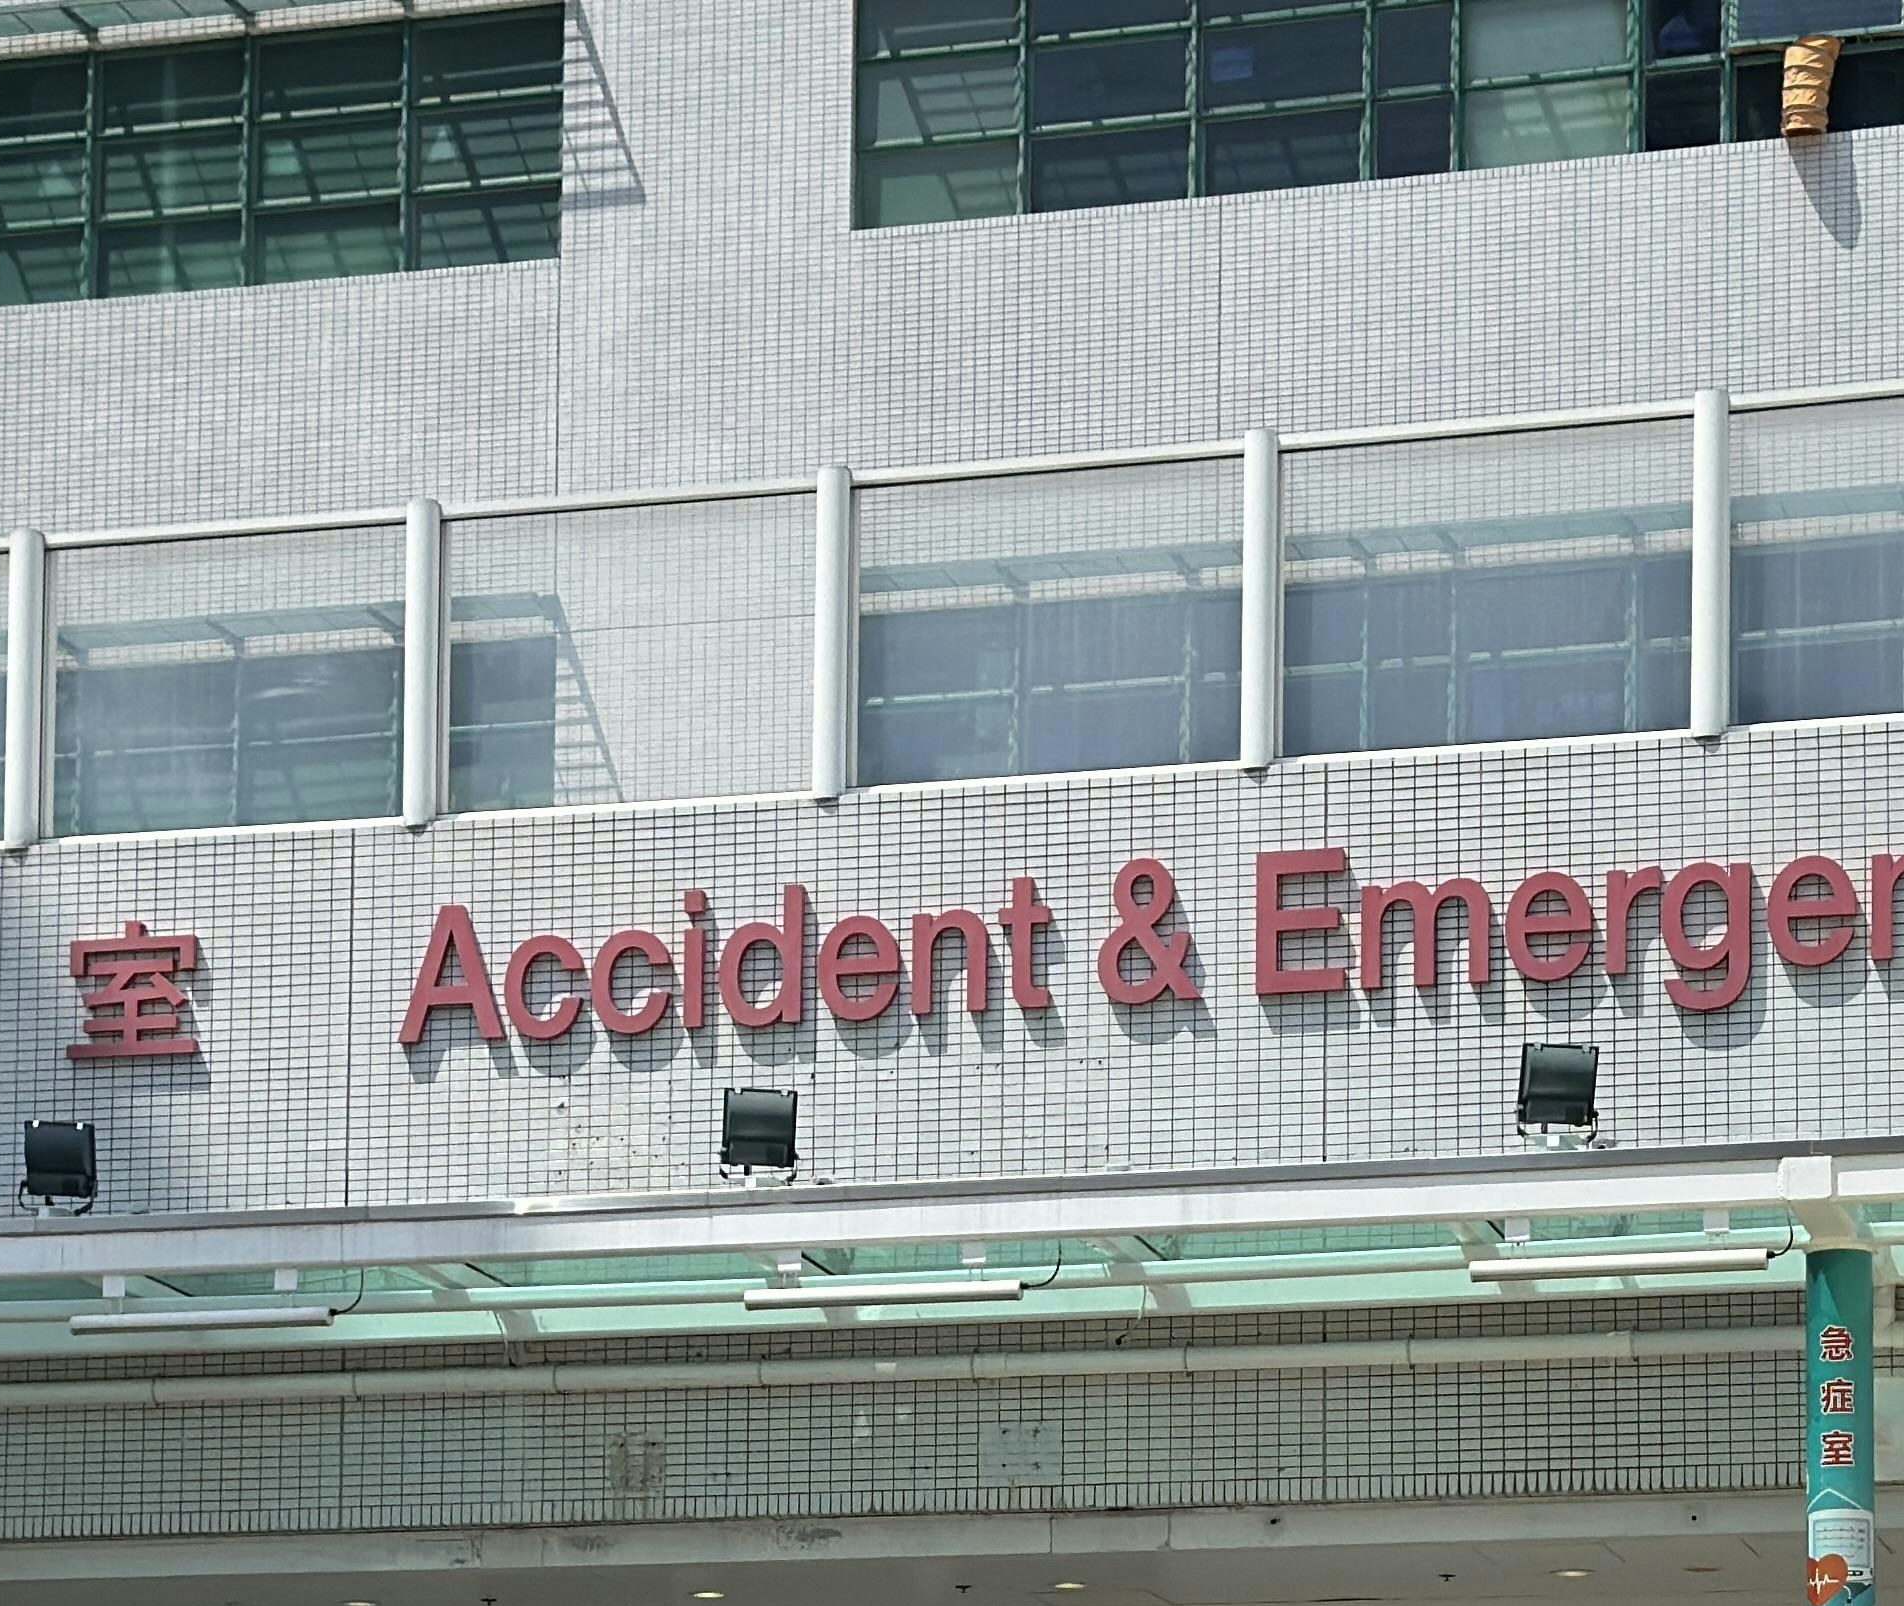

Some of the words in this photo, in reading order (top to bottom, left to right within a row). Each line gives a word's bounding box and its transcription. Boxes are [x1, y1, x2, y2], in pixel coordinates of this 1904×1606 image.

[399, 884, 1050, 1046] Accident
[1097, 858, 1200, 1007] &
[1818, 1325, 1854, 1468] 急症室
